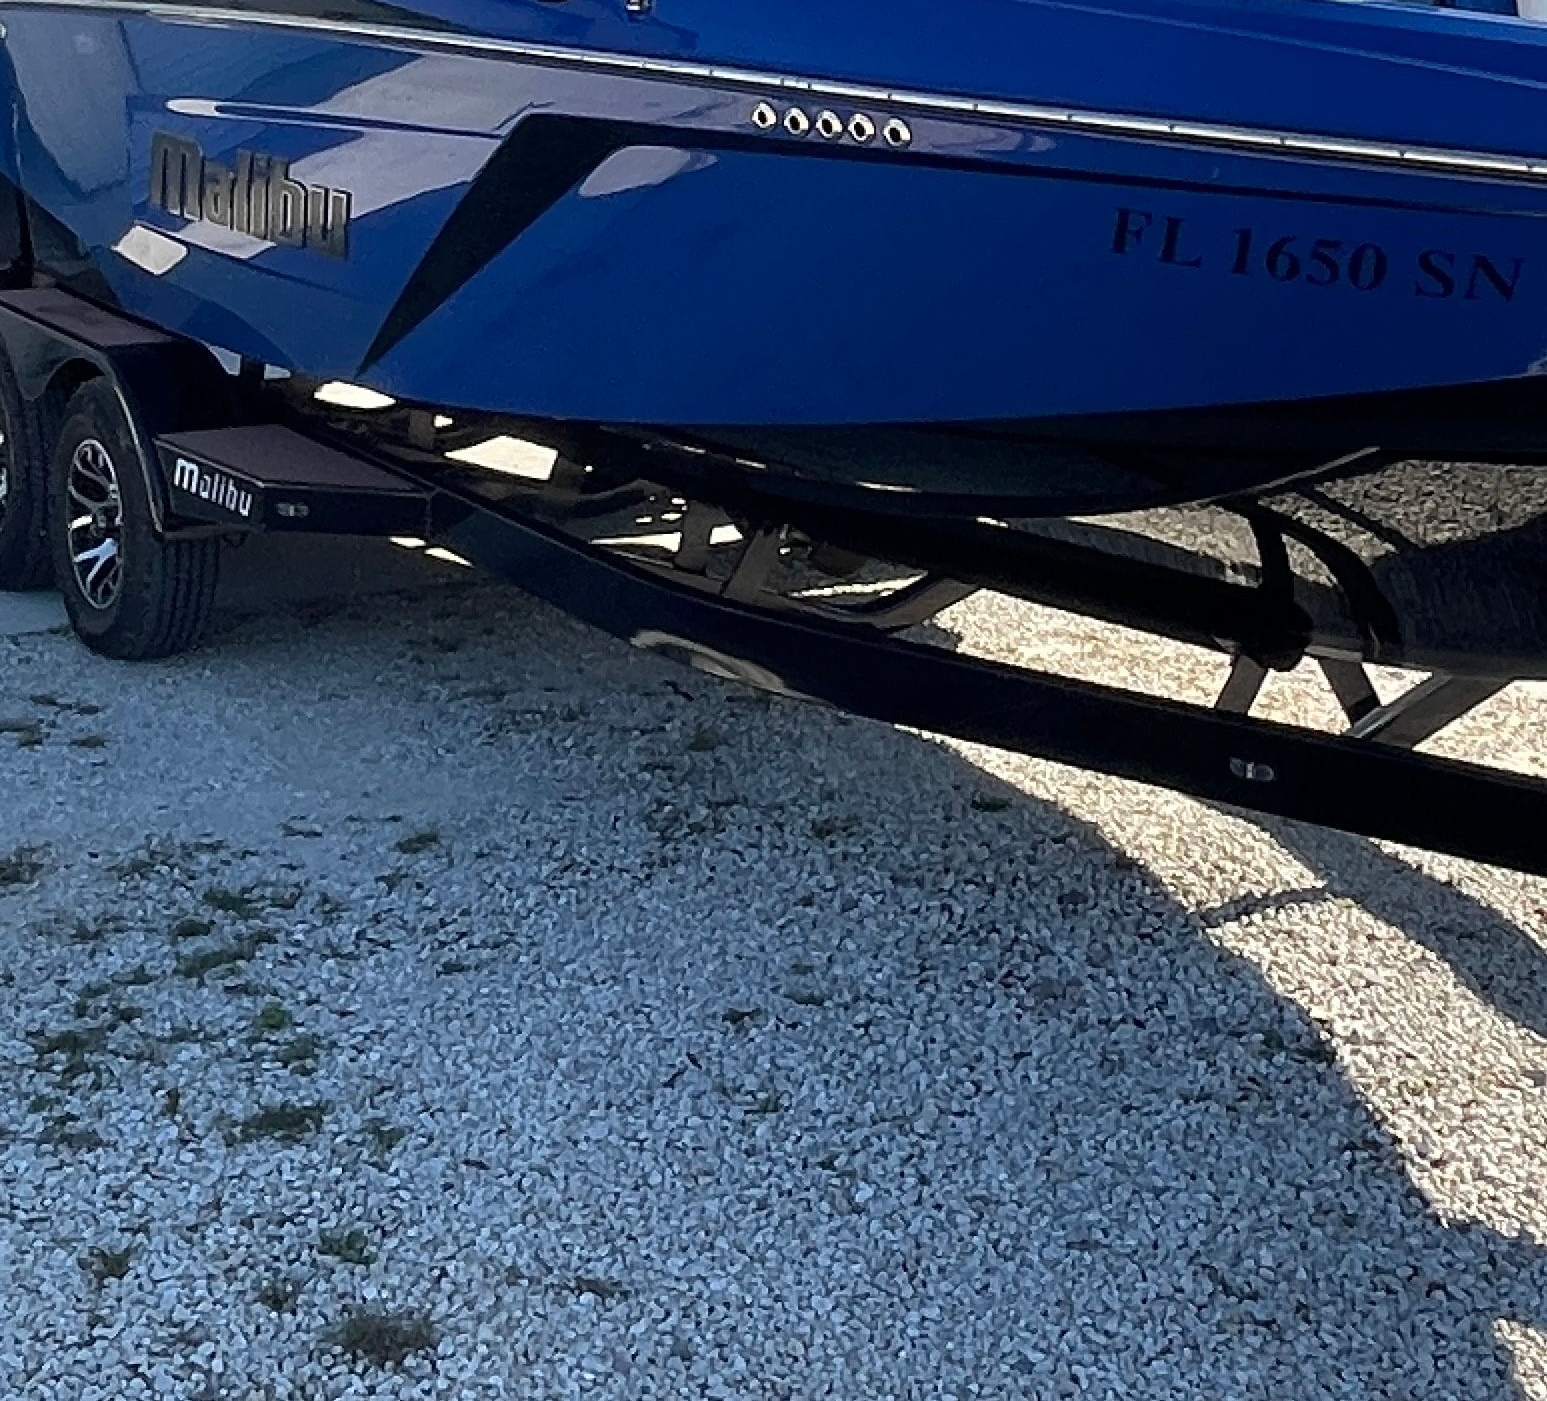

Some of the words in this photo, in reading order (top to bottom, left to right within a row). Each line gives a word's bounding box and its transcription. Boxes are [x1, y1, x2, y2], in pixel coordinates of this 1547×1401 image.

[151, 131, 352, 261] Malibu
[1112, 206, 1203, 269] FL
[1230, 226, 1388, 292] 1650
[1414, 249, 1525, 302] SN
[173, 457, 252, 517] Malibu
